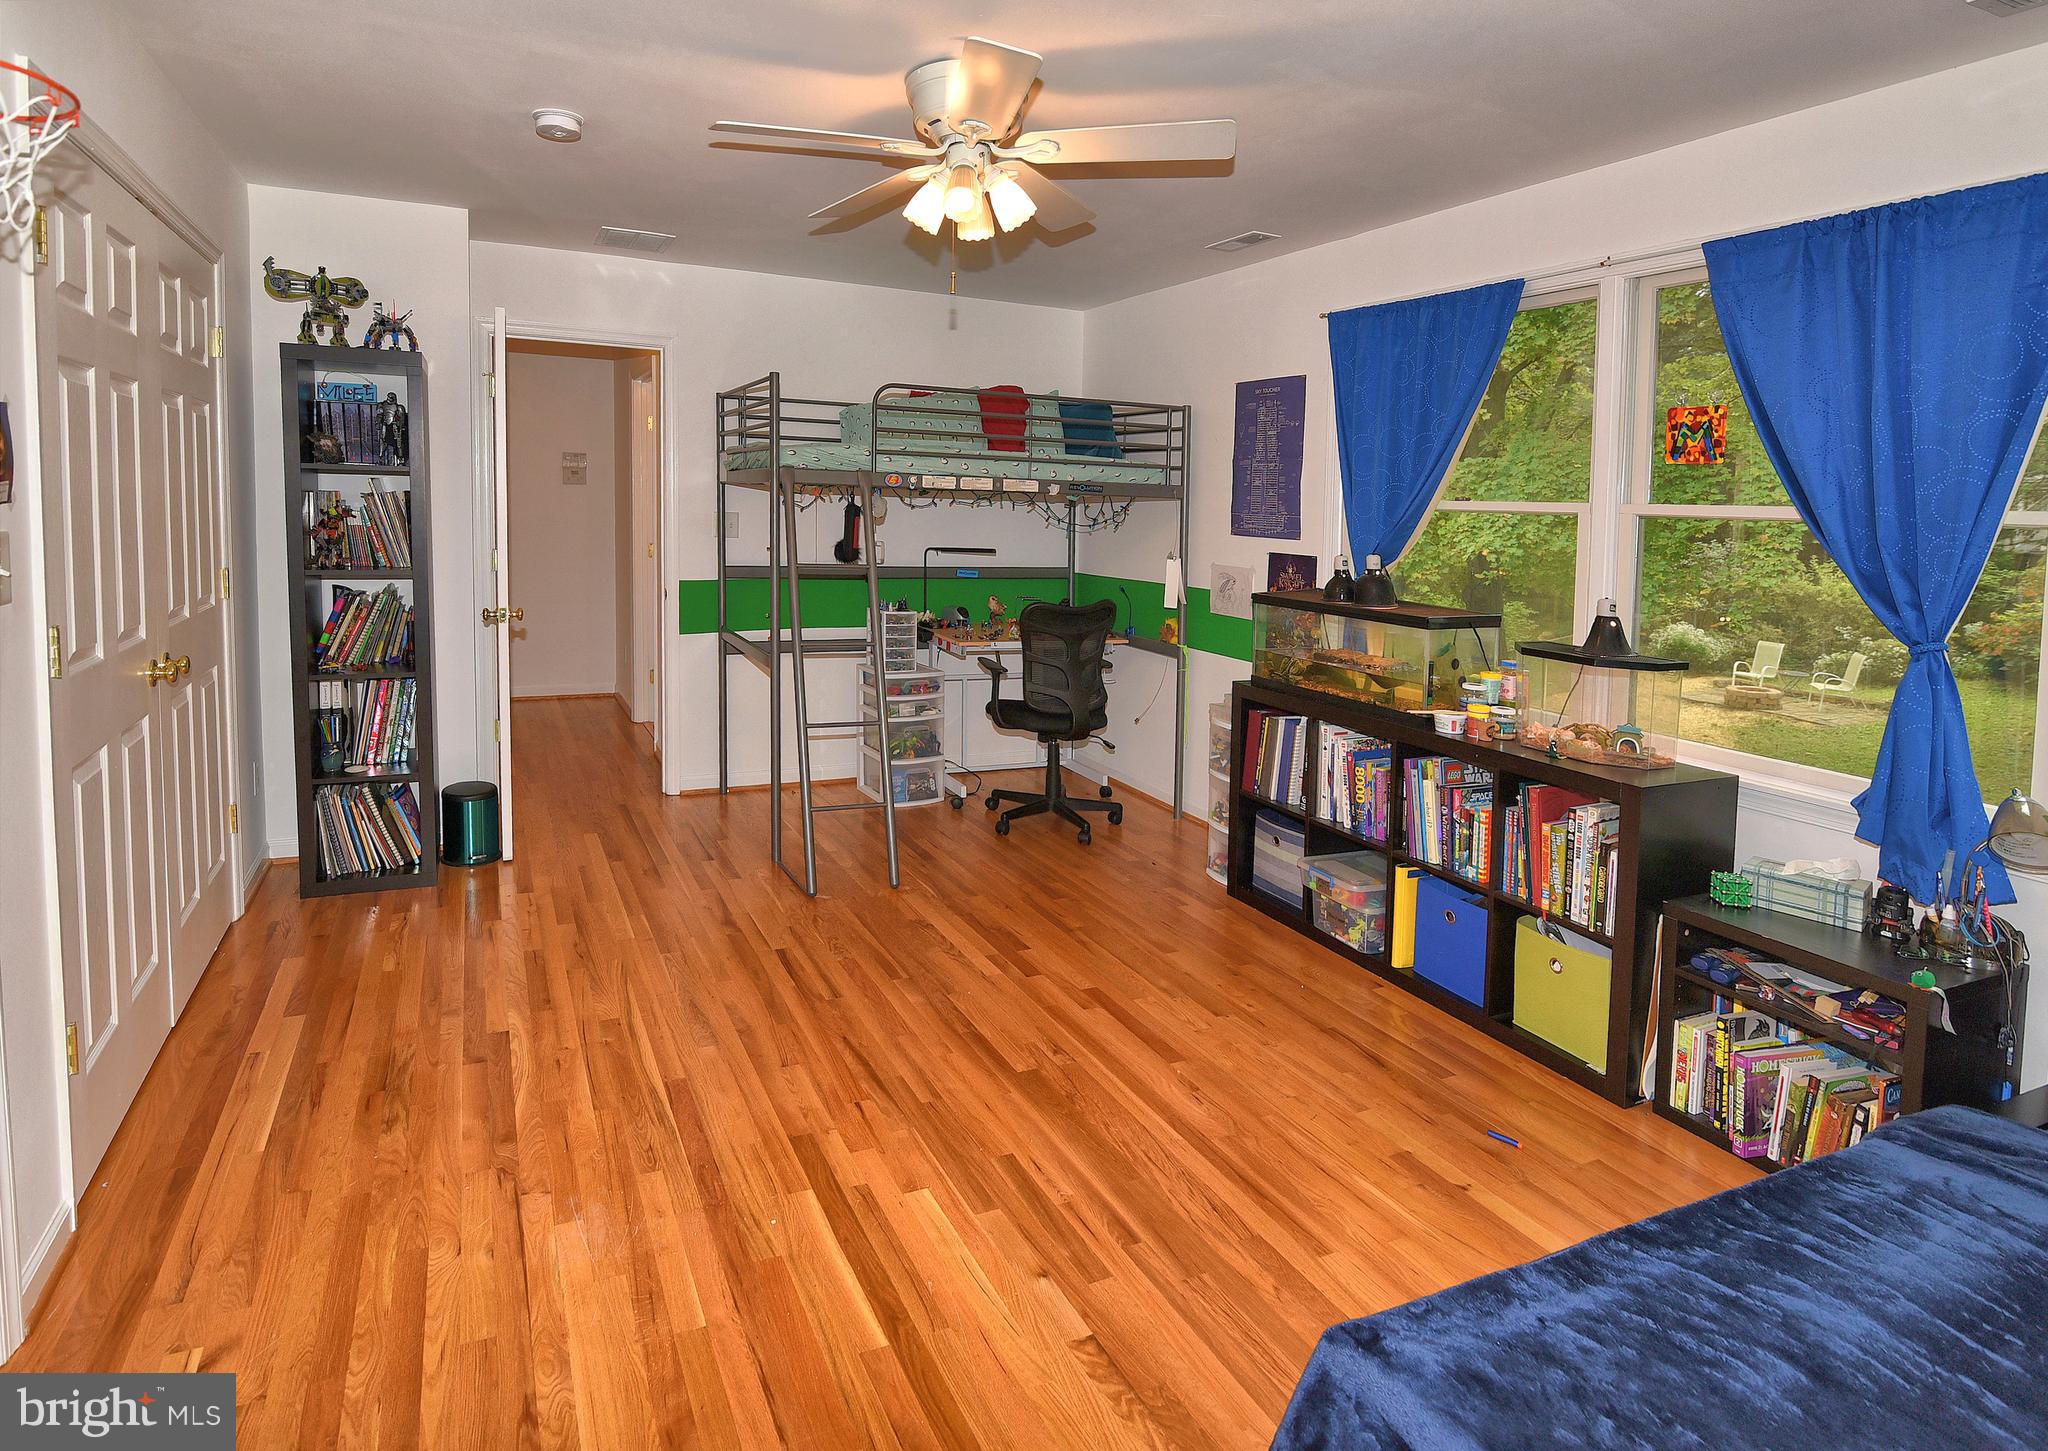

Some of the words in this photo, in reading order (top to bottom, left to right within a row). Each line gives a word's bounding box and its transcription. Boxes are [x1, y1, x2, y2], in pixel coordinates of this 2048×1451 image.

[317, 384, 375, 401] MILES
[1355, 766, 1366, 804] 8000
[1448, 771, 1461, 780] LEGO
[1470, 791, 1493, 801] SPACE
[1715, 1029, 1725, 1069] WATCHMEN
[1735, 1065, 1746, 1133] HOMESTUCK
